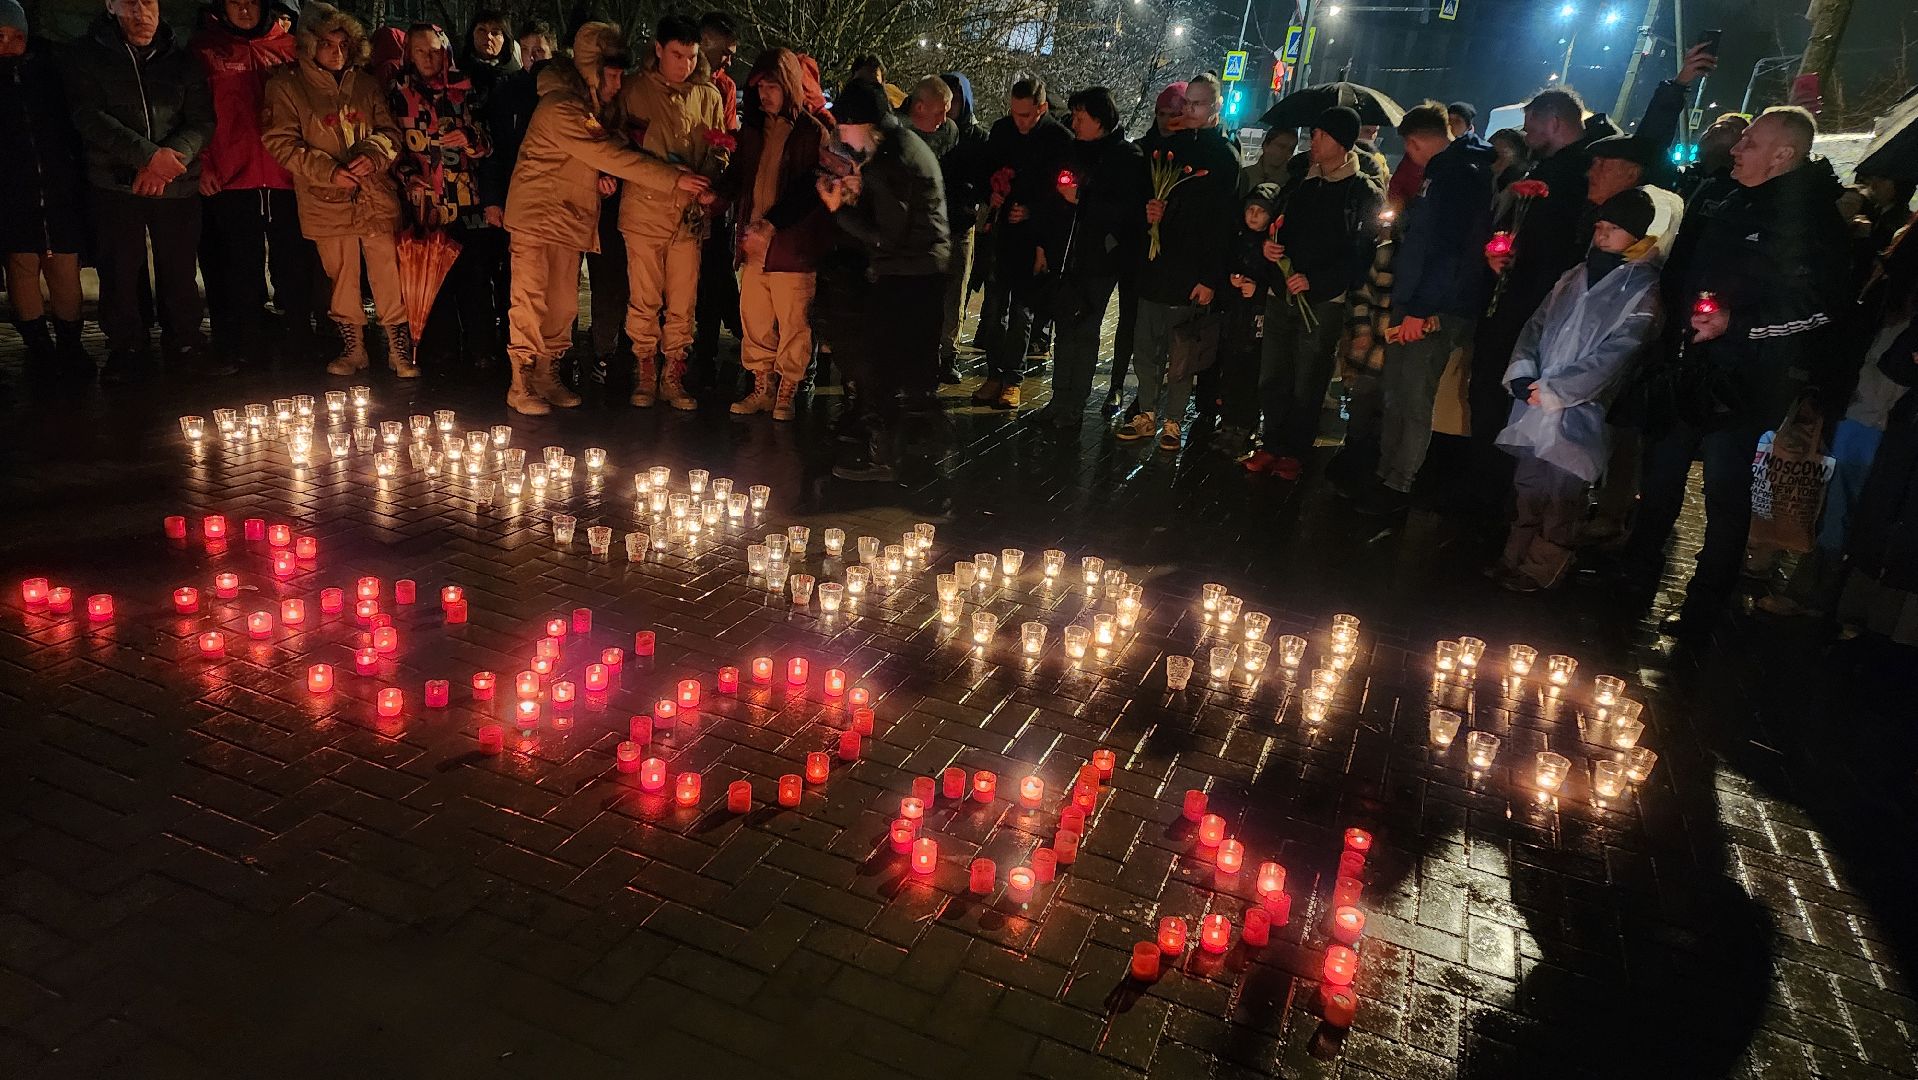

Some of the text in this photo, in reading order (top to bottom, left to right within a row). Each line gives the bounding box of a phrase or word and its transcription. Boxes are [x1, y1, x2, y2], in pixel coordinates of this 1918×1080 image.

[1751, 465, 1777, 482] OKYO
[1763, 452, 1828, 478] MOSCOW
[1796, 487, 1817, 497] YOR
